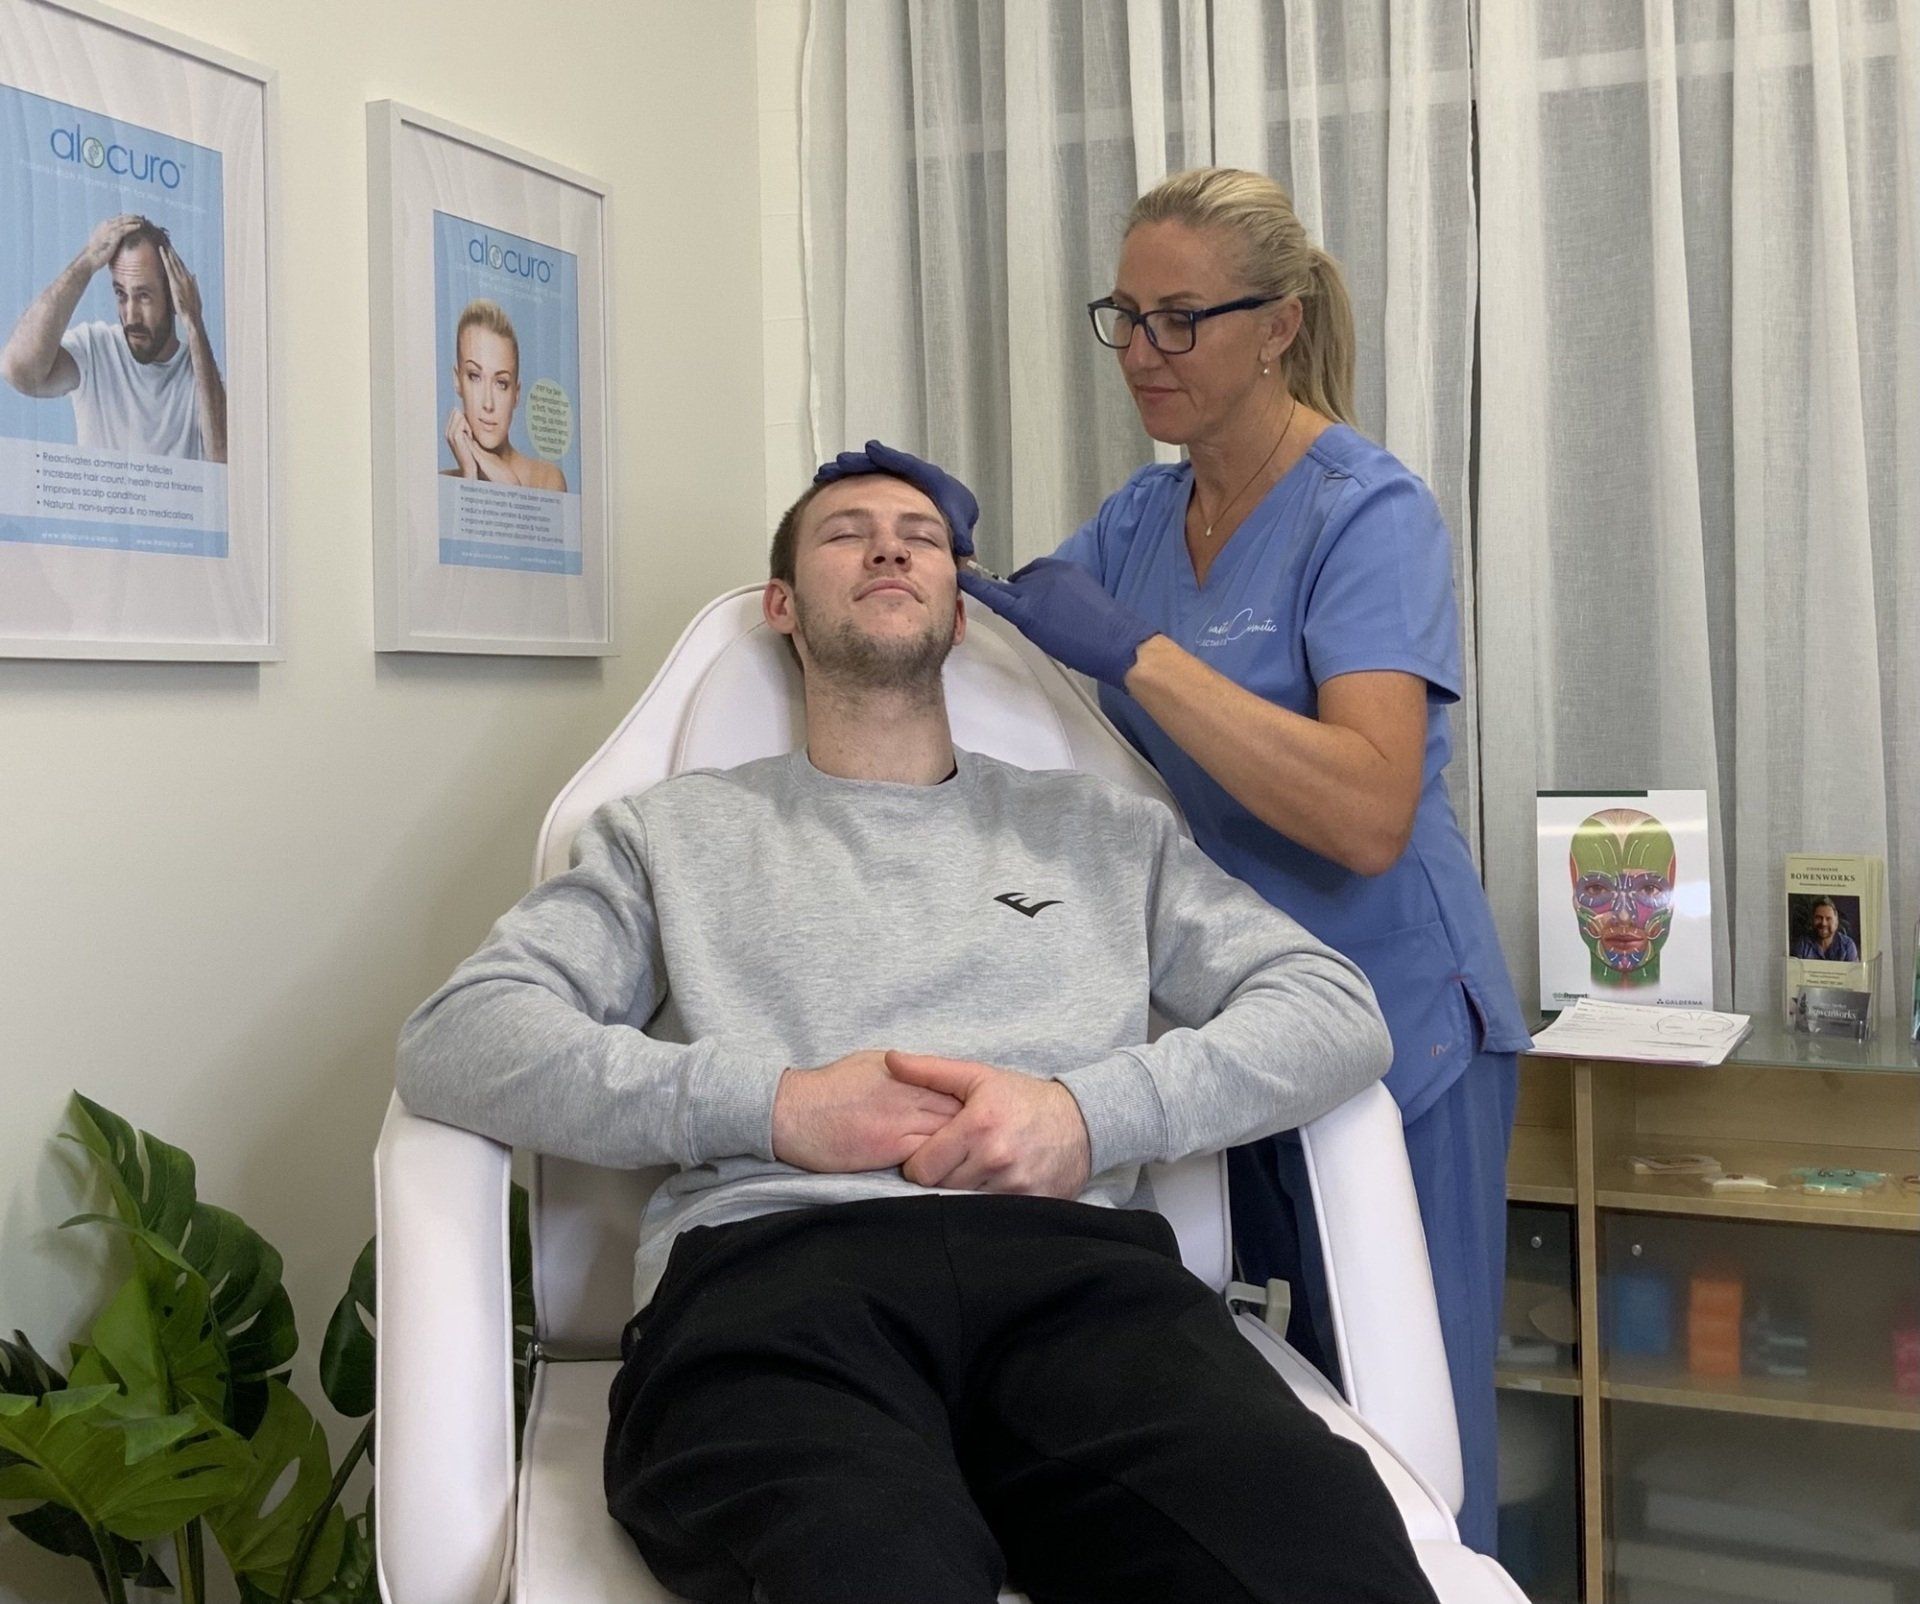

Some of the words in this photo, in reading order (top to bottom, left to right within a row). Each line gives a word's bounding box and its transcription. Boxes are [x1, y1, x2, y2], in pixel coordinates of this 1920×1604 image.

[43, 452, 92, 466] Reactivates
[93, 459, 129, 471] dormant
[130, 462, 144, 472] hair
[43, 469, 81, 480] Increases
[84, 472, 98, 481] hair
[154, 481, 169, 489] and
[43, 483, 81, 496] Improves
[82, 488, 105, 499] scalp
[106, 490, 147, 501] conditions
[137, 508, 147, 516] no
[149, 509, 194, 521] medications
[1790, 872, 1856, 881] BOWENWORKS
[1664, 999, 1704, 1007] GALDERMA
